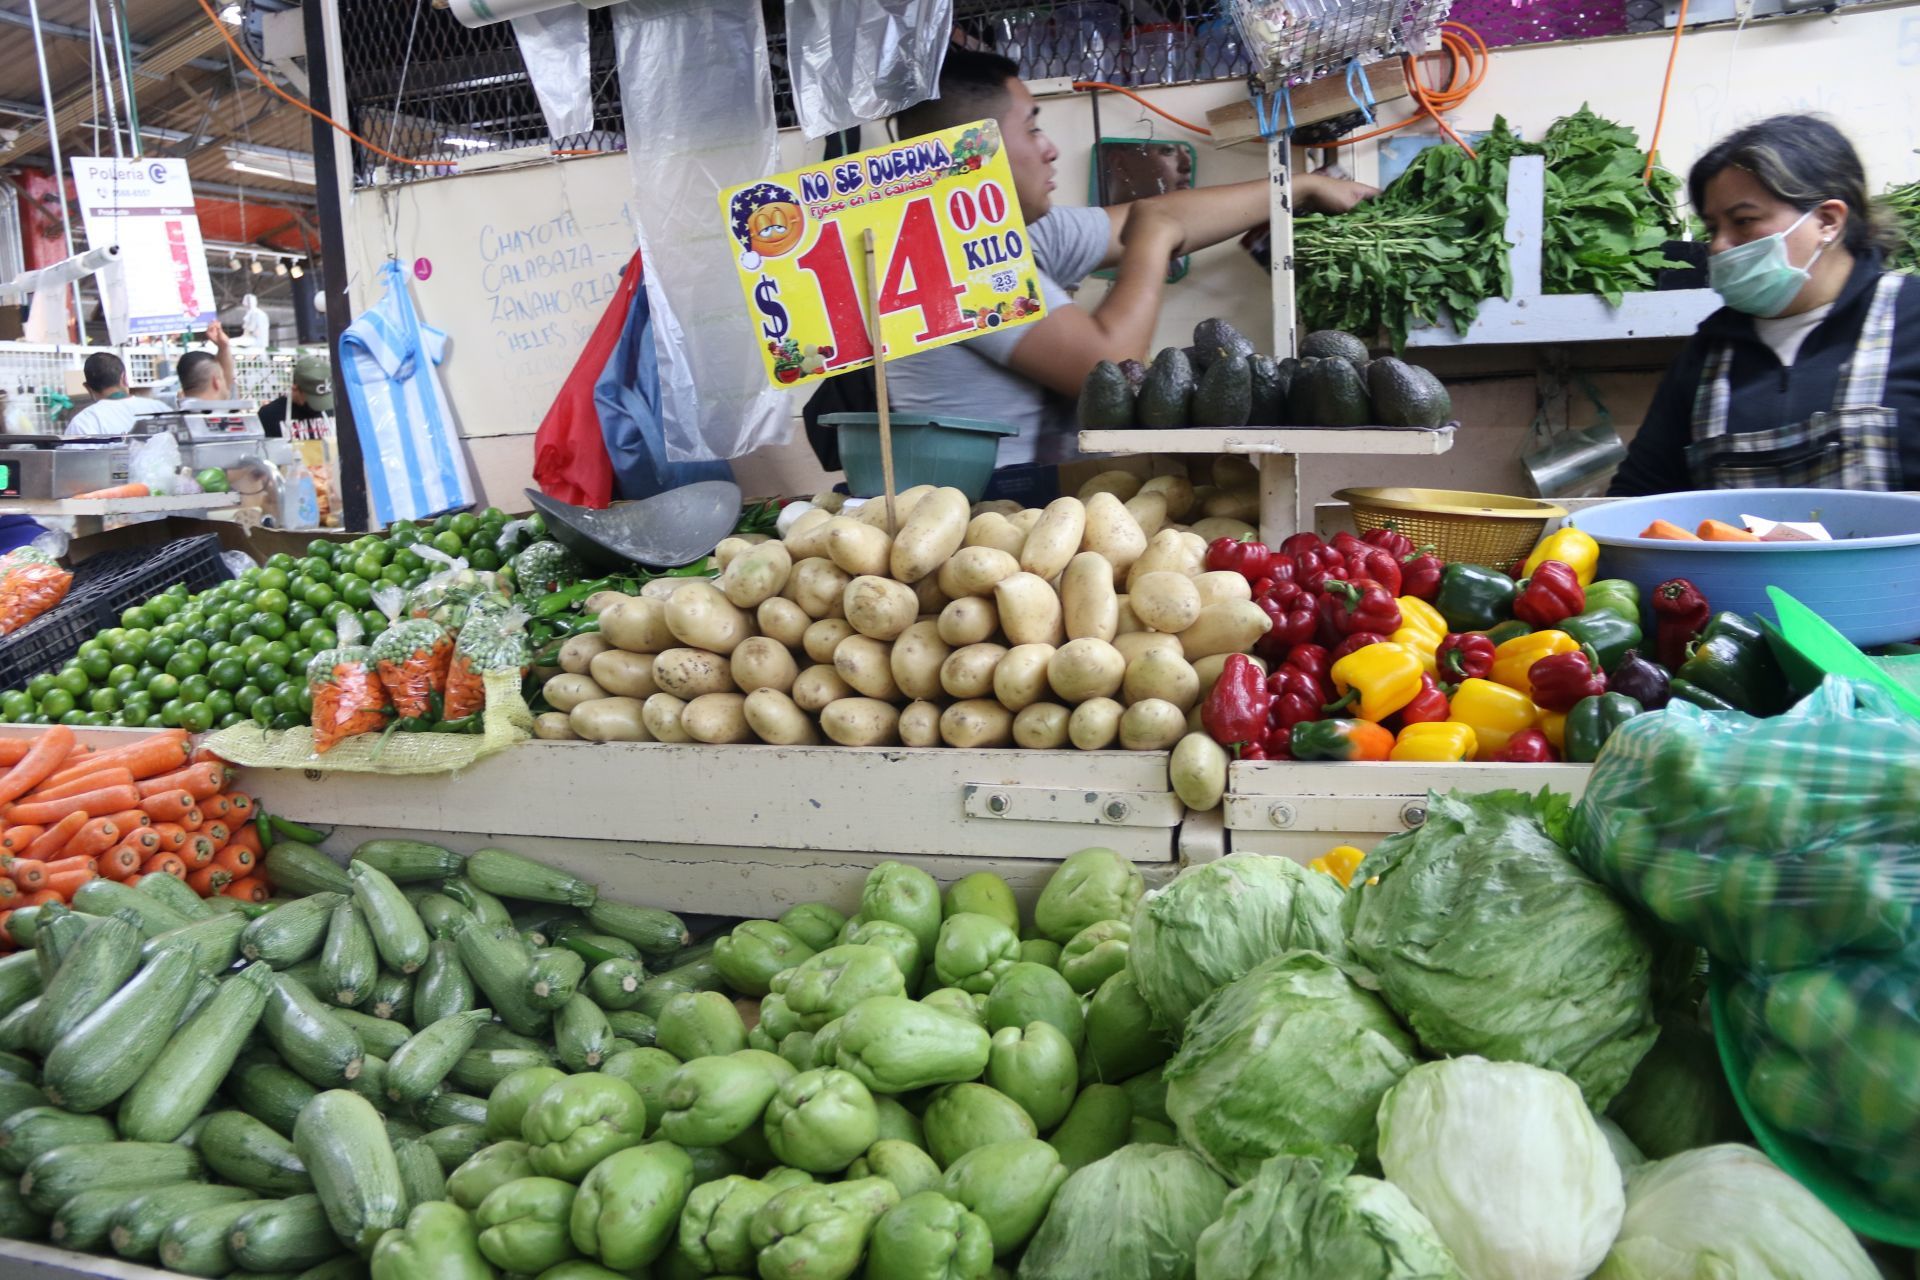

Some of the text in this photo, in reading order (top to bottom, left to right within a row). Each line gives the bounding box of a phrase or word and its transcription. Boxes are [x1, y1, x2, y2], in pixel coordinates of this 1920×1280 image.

[800, 140, 950, 203] NO SE DUERMA
[850, 196, 865, 207] en
[868, 190, 881, 201] la
[885, 176, 934, 197] calidad
[481, 243, 594, 294] CALABAZA
[754, 183, 1005, 368] $ 14 00
[962, 231, 1023, 270] KILO
[487, 272, 618, 323] ZANAHORIA
[995, 274, 1012, 287] 23
